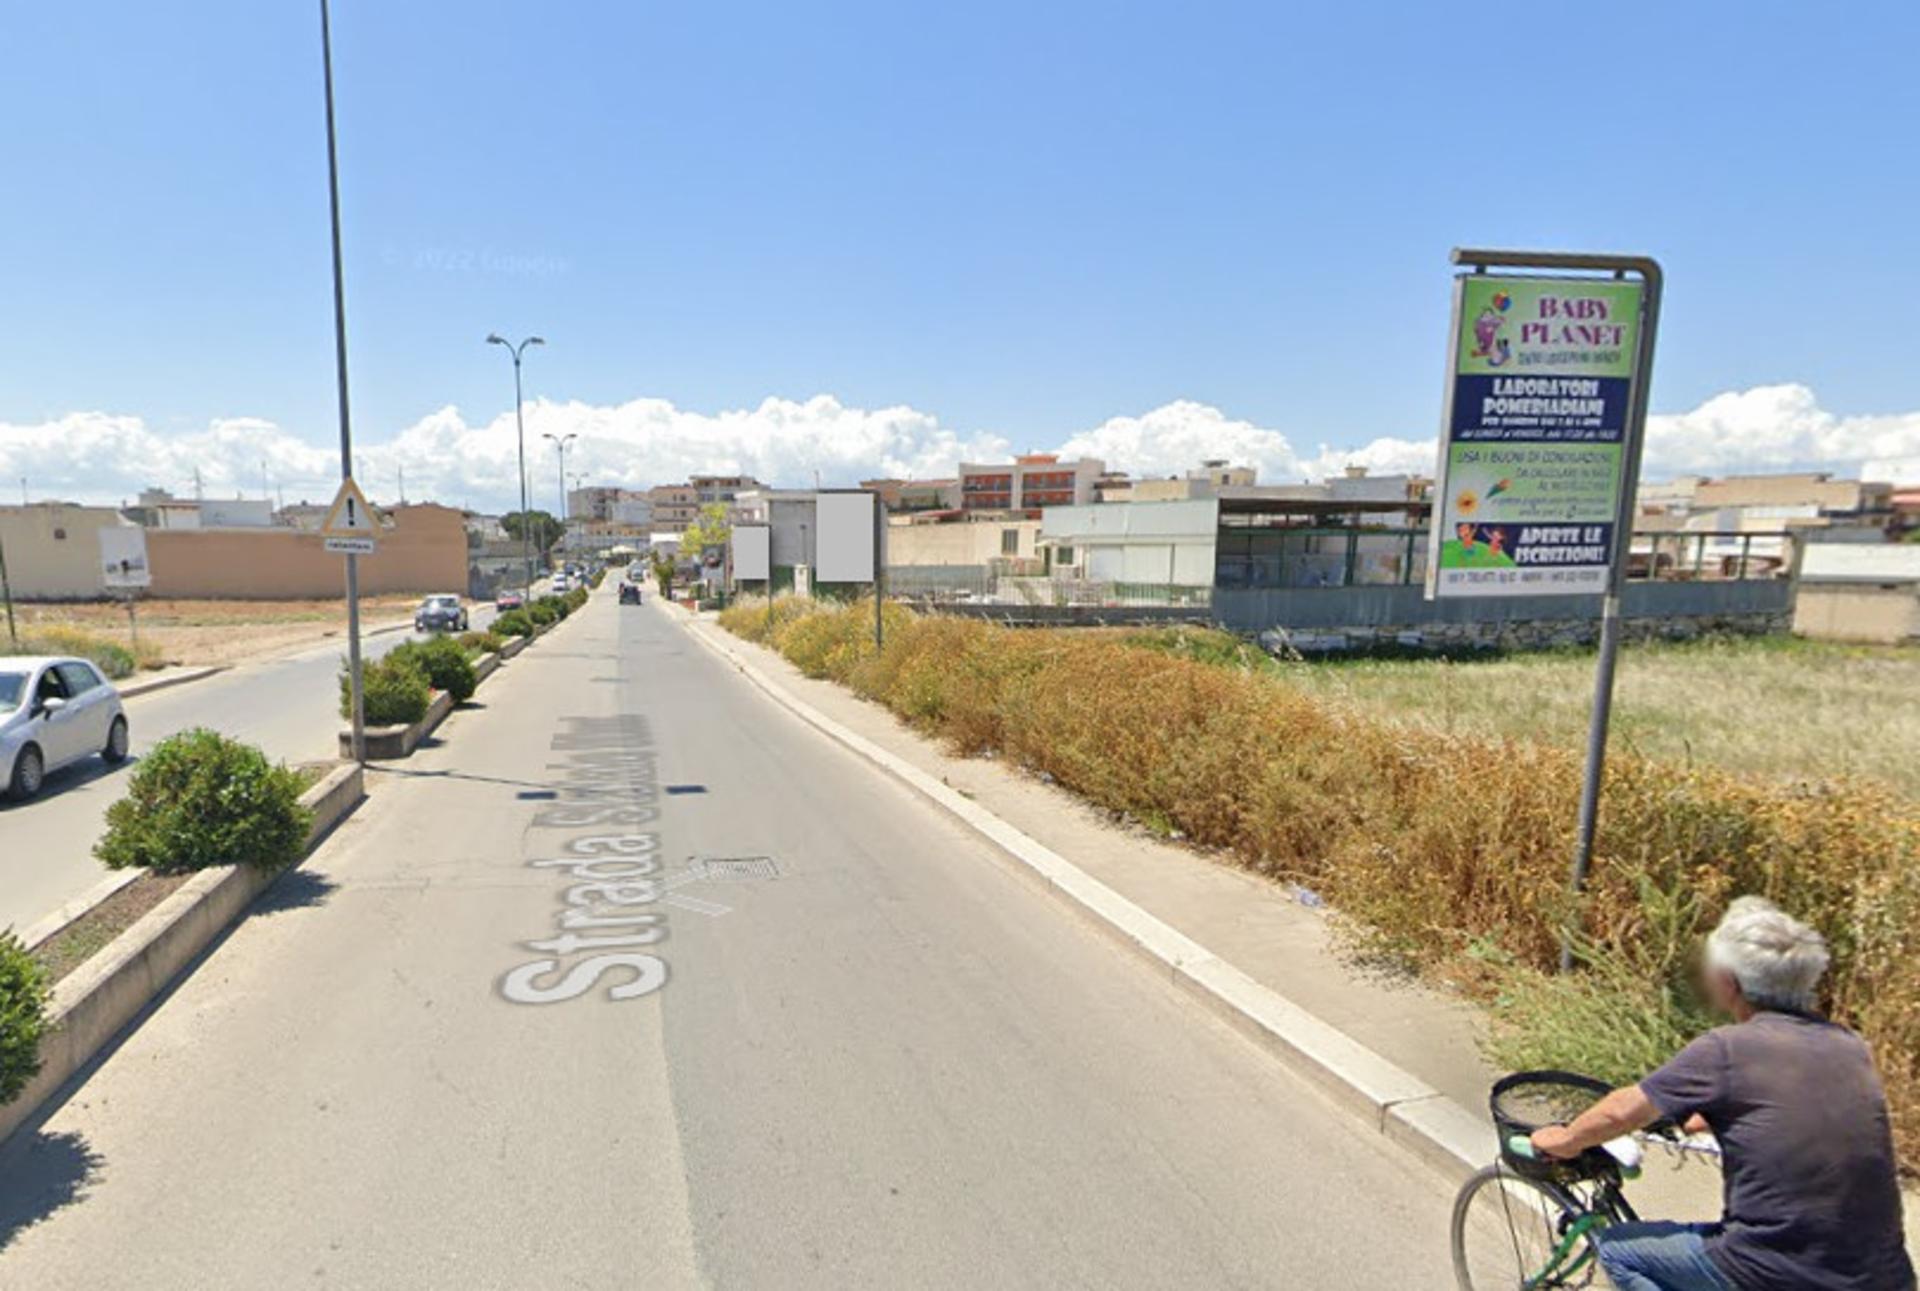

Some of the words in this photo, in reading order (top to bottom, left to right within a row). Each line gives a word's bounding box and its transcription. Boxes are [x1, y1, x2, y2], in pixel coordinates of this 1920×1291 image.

[1539, 297, 1609, 320] BABY
[1521, 322, 1627, 347] PLANET
[1493, 378, 1600, 397] LABORATORI
[1517, 527, 1581, 545] APERTE
[1584, 527, 1603, 545] LE
